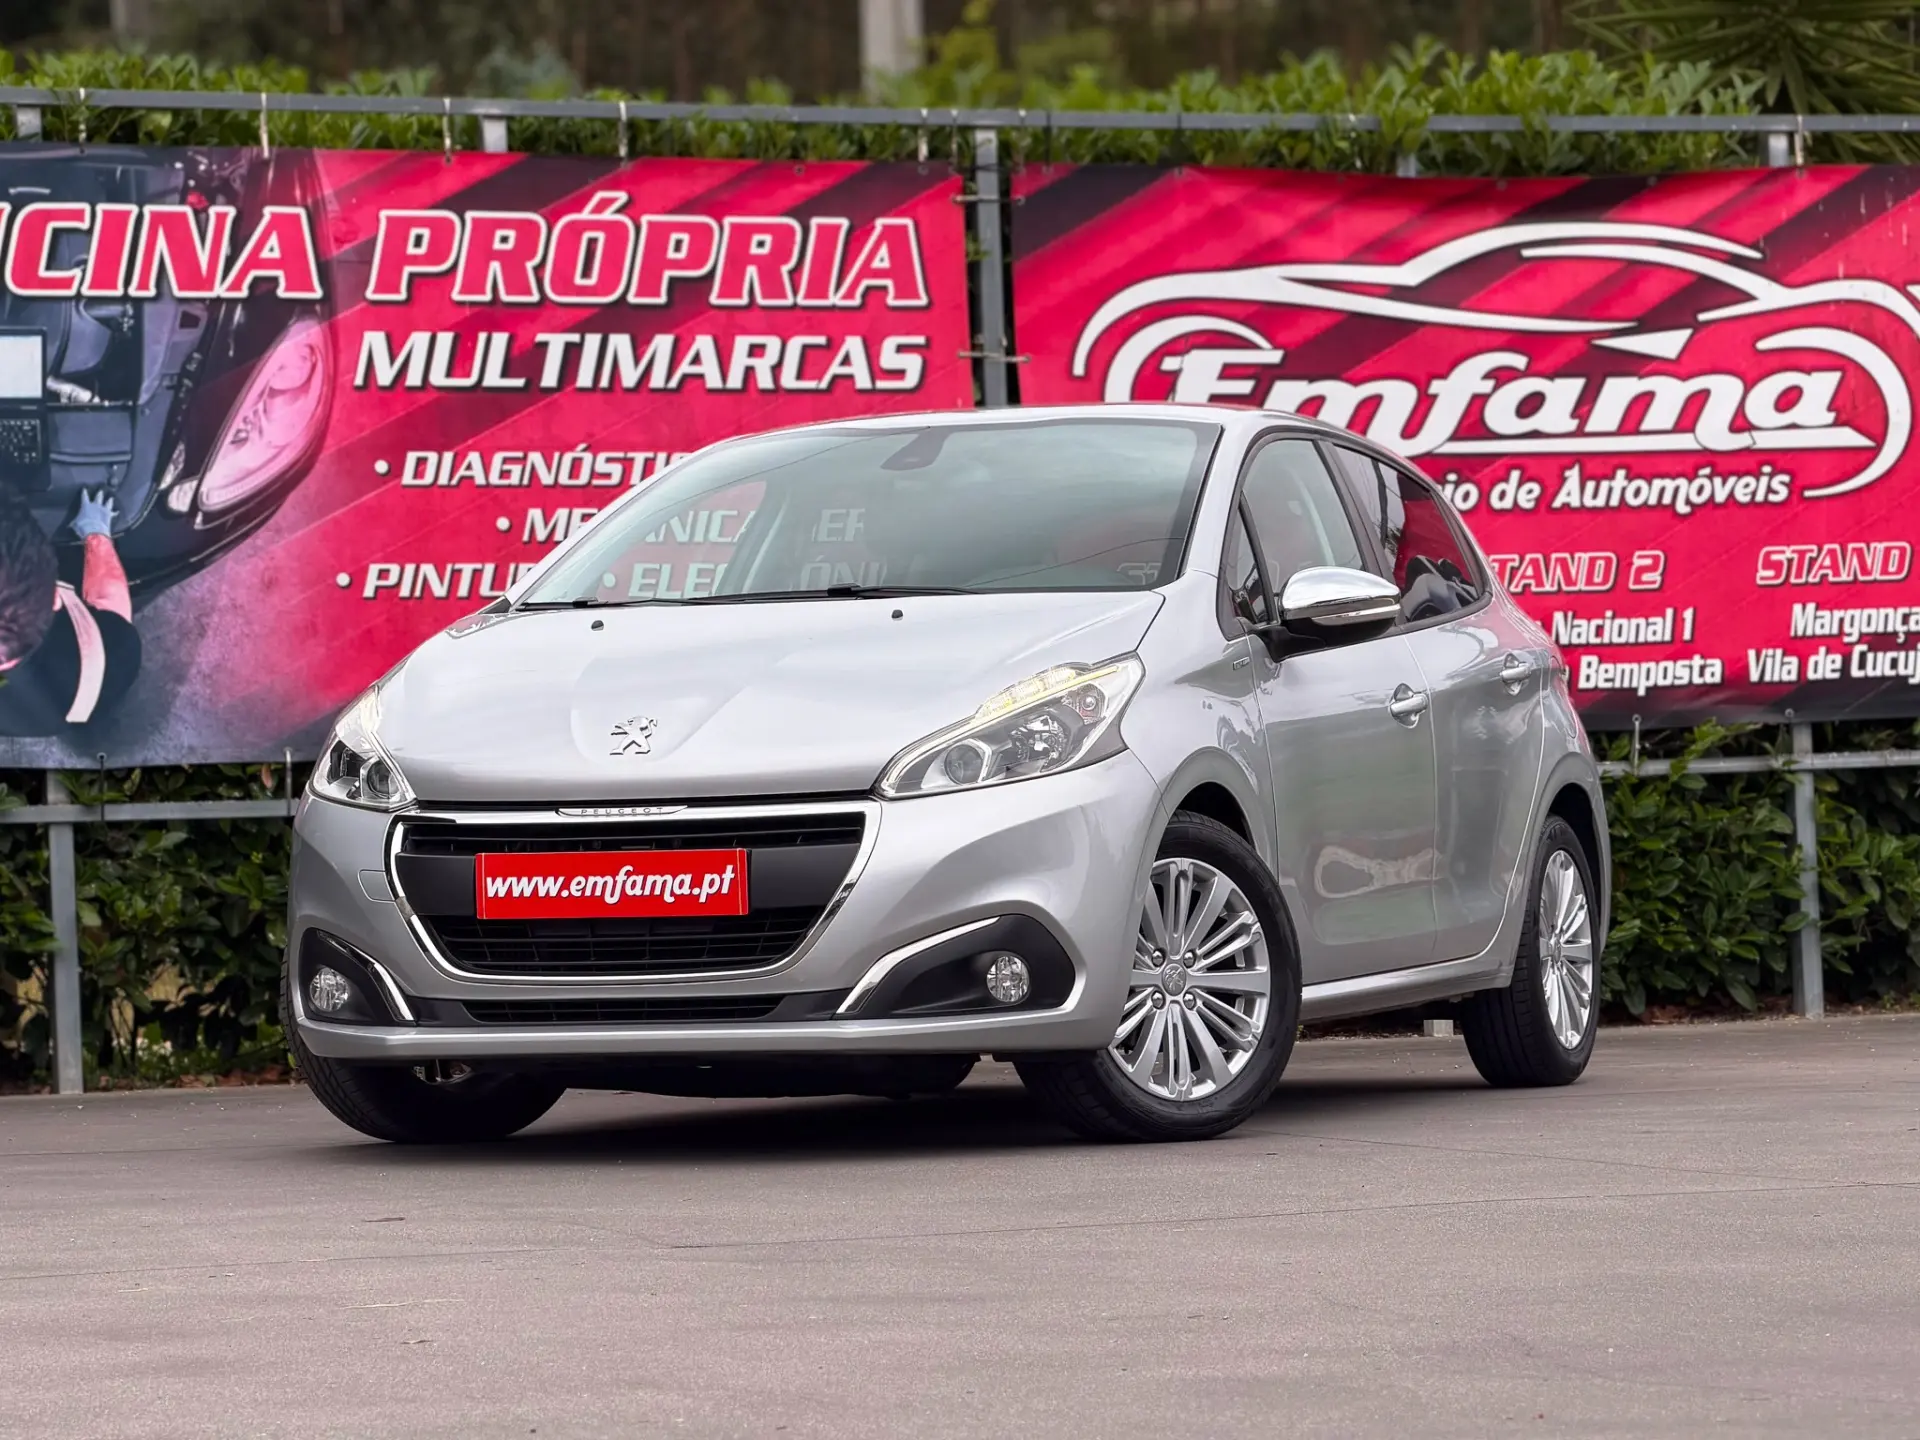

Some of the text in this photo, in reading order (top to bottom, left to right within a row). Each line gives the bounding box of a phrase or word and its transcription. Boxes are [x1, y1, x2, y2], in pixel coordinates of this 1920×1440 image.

[0, 191, 930, 306] CINA PRÓPRIA
[353, 331, 928, 390] MULTIMARCAS
[1160, 348, 1842, 457] Emfama
[401, 443, 692, 486] DIAGNÓSTI
[1490, 468, 1542, 510] de
[1552, 463, 1790, 514] Automóveis
[363, 563, 536, 598] PINTU
[1489, 550, 1665, 593] TAND 2
[1756, 541, 1912, 585] STAND
[1552, 606, 1695, 647] Nacional 1
[1578, 655, 1723, 696] Bemposta
[1748, 648, 1799, 682] Vila
[1807, 645, 1842, 680] de
[581, 807, 663, 815] PEUGEOT
[485, 864, 735, 905] www.emfama.pt
